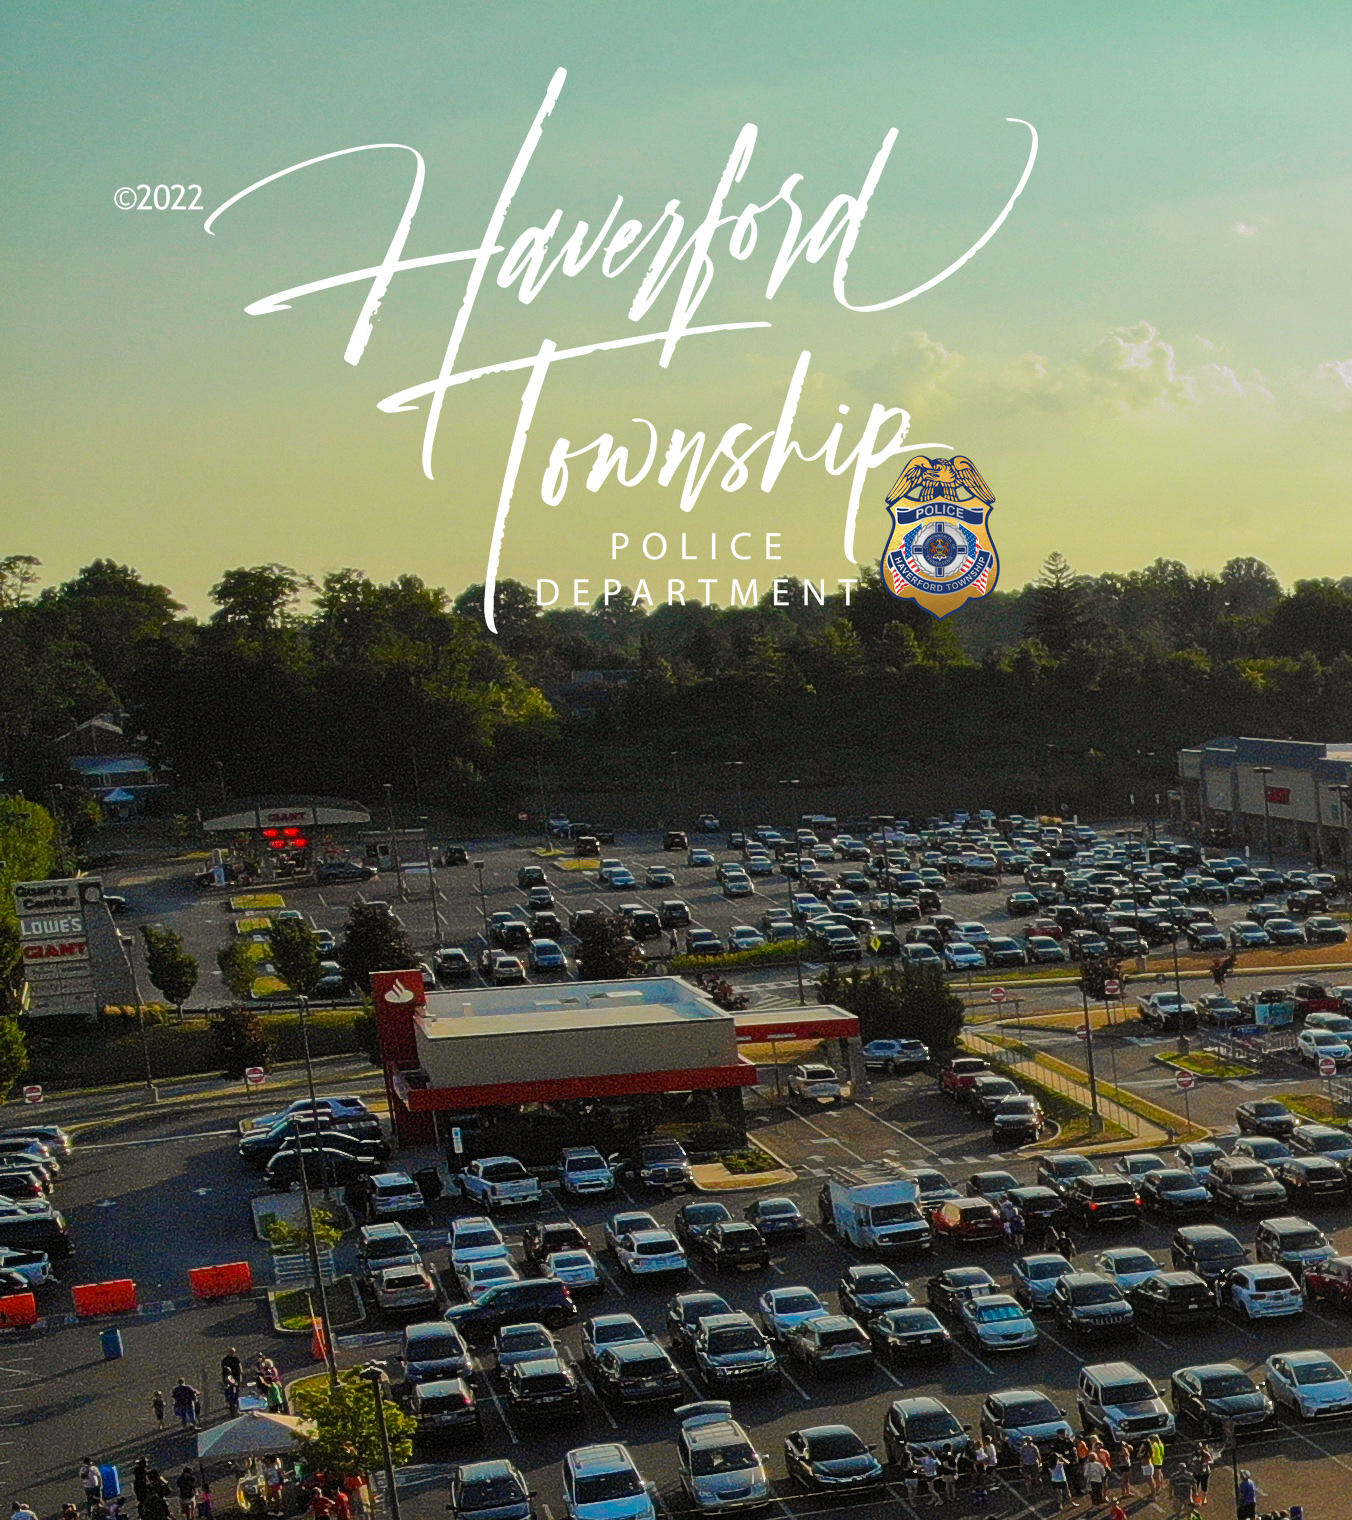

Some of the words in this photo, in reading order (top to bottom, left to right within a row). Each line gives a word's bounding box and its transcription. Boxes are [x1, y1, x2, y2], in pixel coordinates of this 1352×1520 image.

[22, 896, 78, 910] Center
[20, 915, 82, 937] LOWE'S
[23, 942, 88, 959] GIANT
